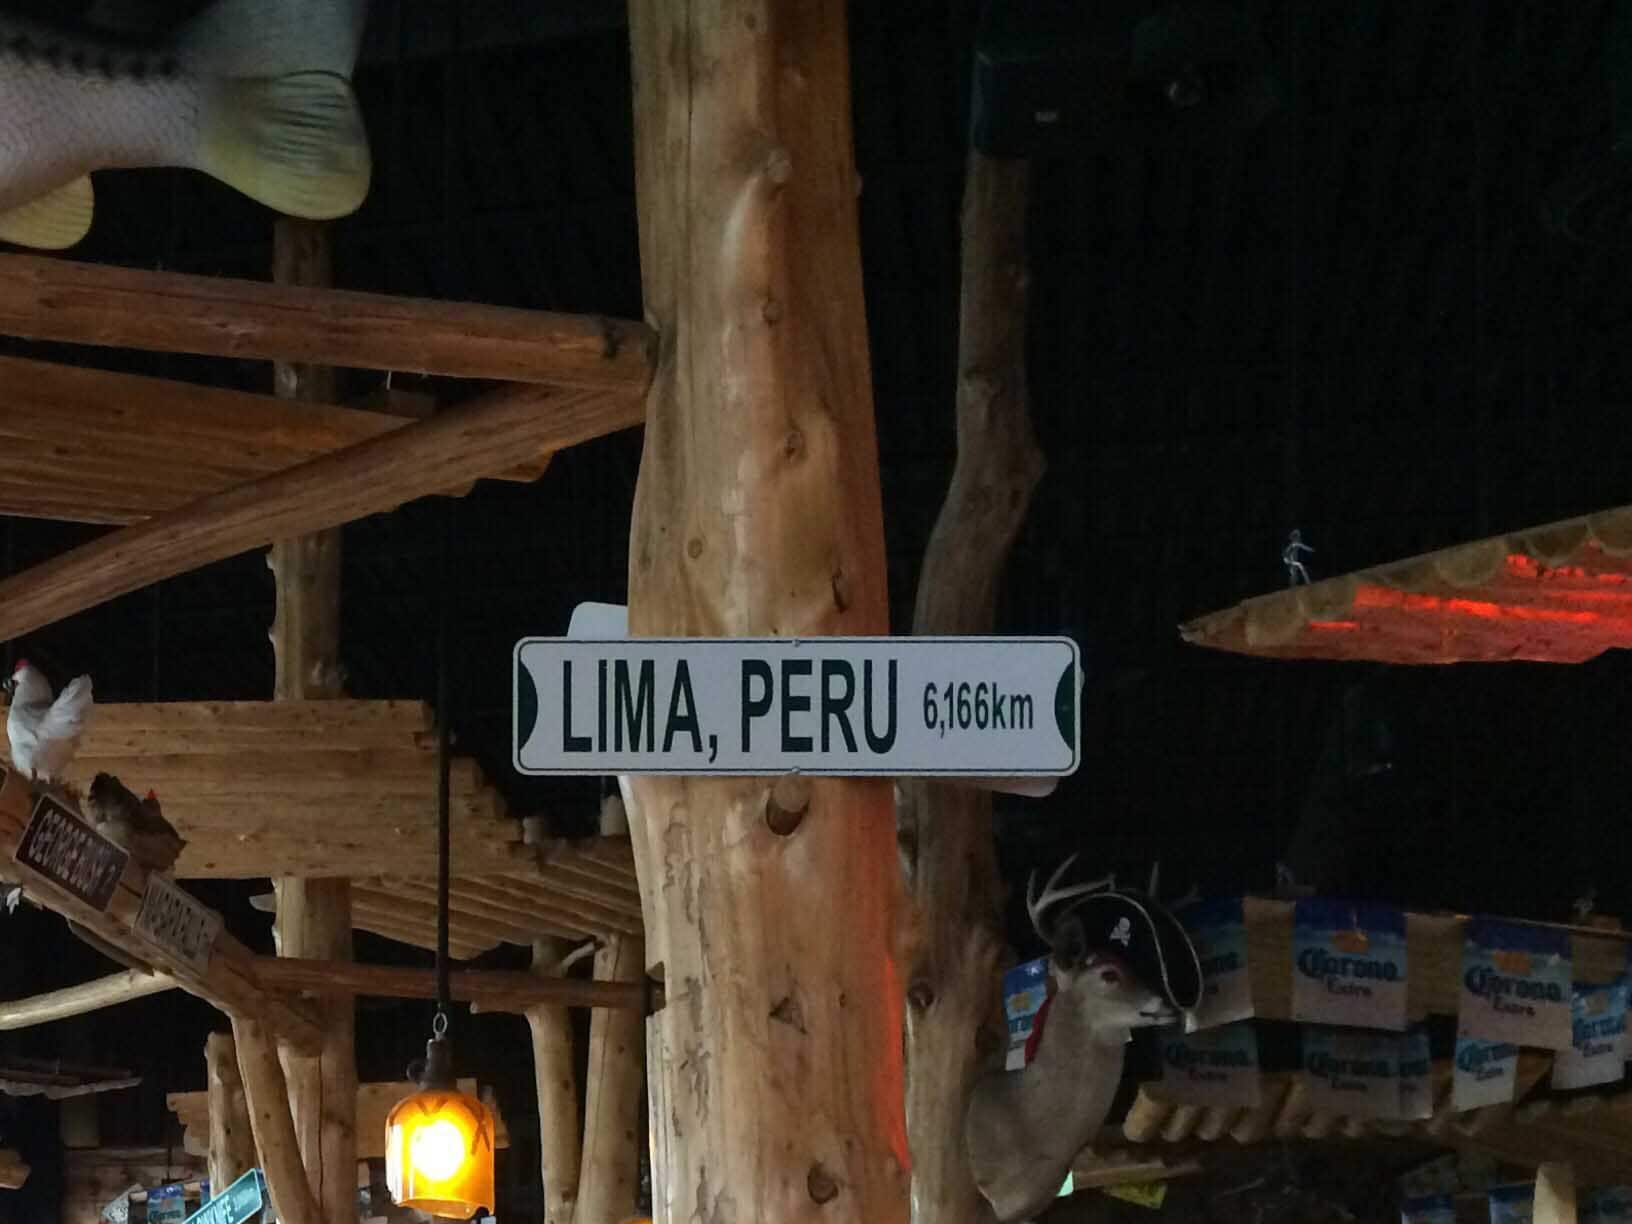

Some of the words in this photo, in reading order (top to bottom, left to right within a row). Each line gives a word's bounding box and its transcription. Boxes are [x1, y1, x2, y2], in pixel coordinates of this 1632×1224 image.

[561, 658, 718, 763] LIMA,
[741, 658, 899, 755] PERU
[923, 681, 1034, 738] 6,166km
